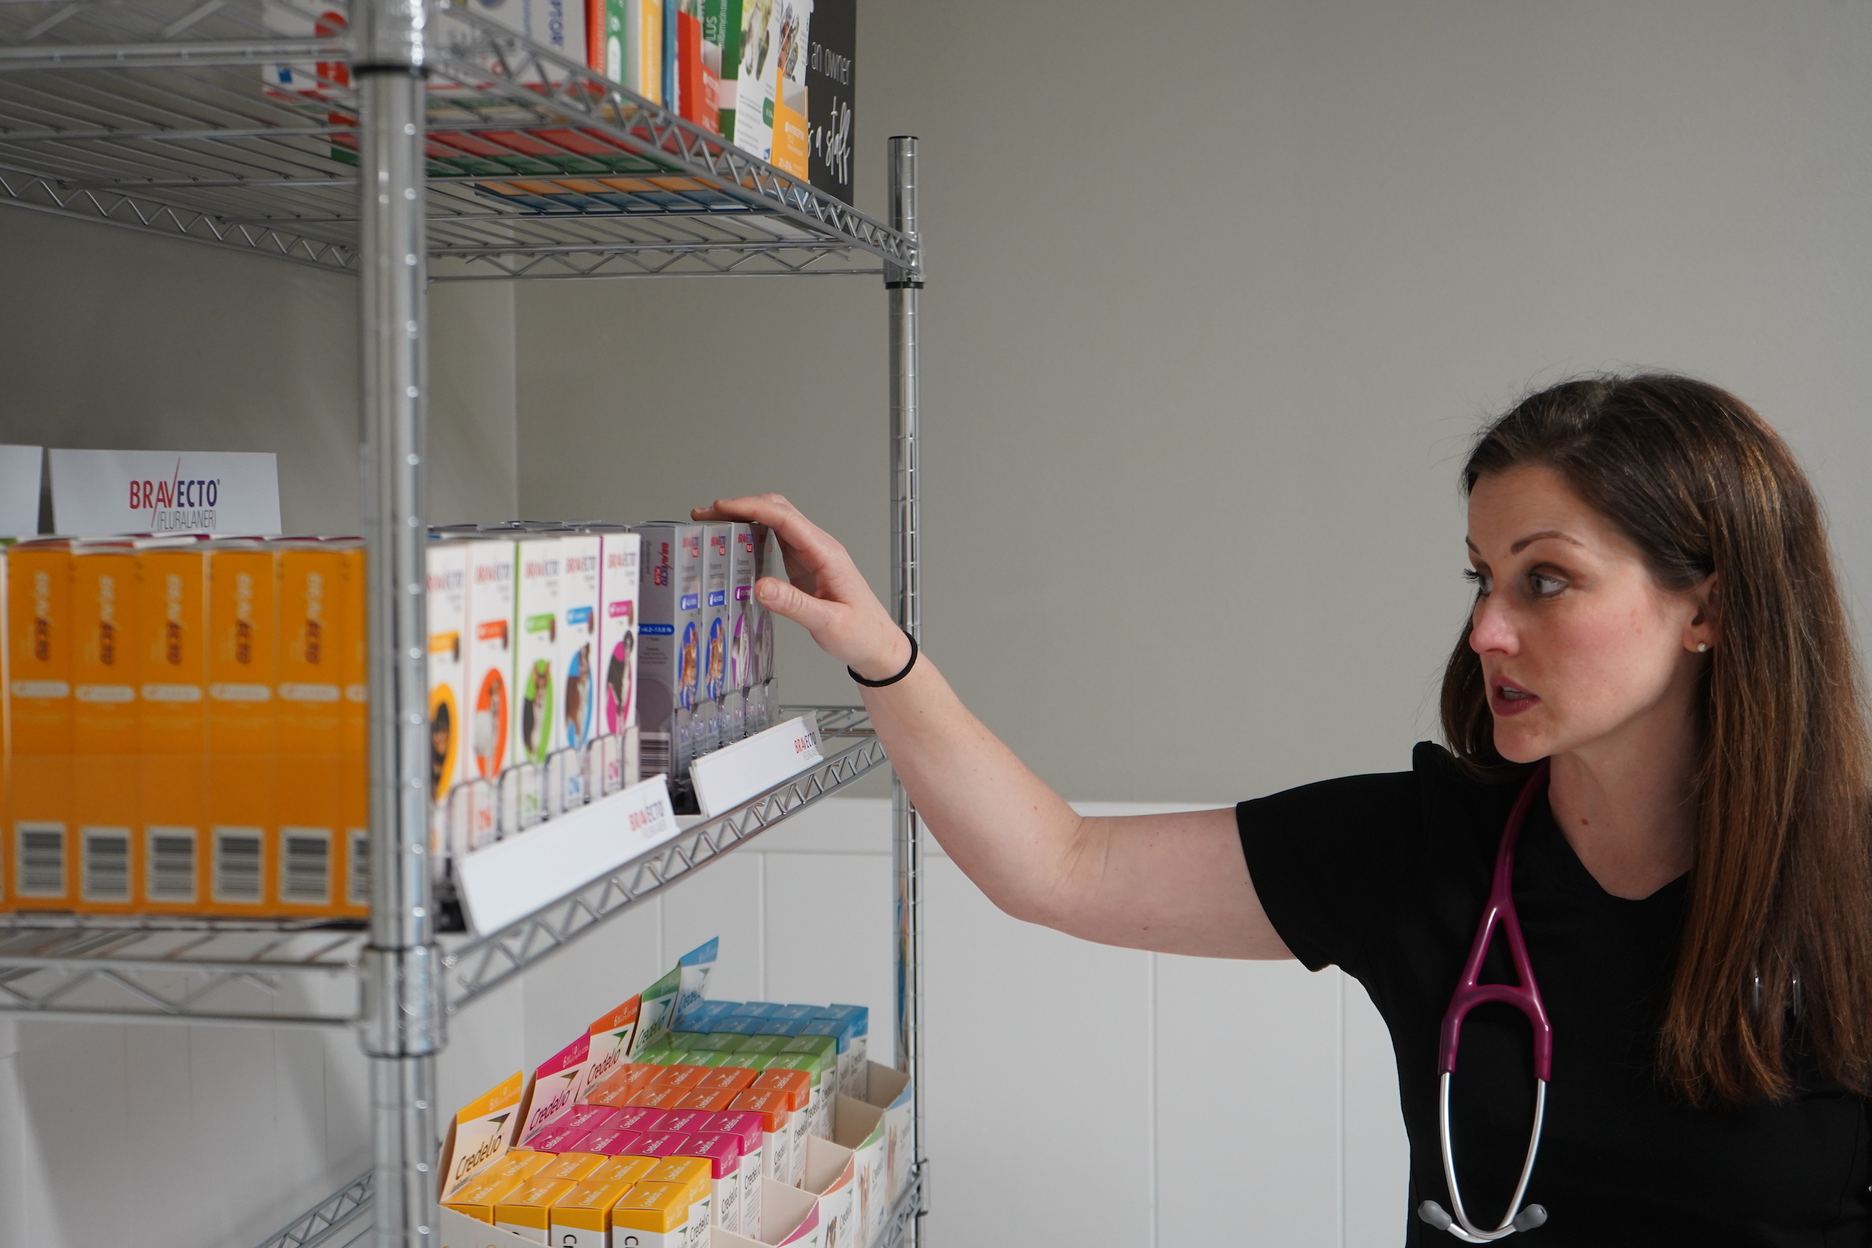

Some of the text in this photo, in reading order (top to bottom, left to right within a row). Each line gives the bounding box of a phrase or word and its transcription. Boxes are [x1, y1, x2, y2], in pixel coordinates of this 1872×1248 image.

[825, 48, 851, 86] owner
[529, 1089, 572, 1131] Credelio
[455, 1134, 503, 1181] Credelio
